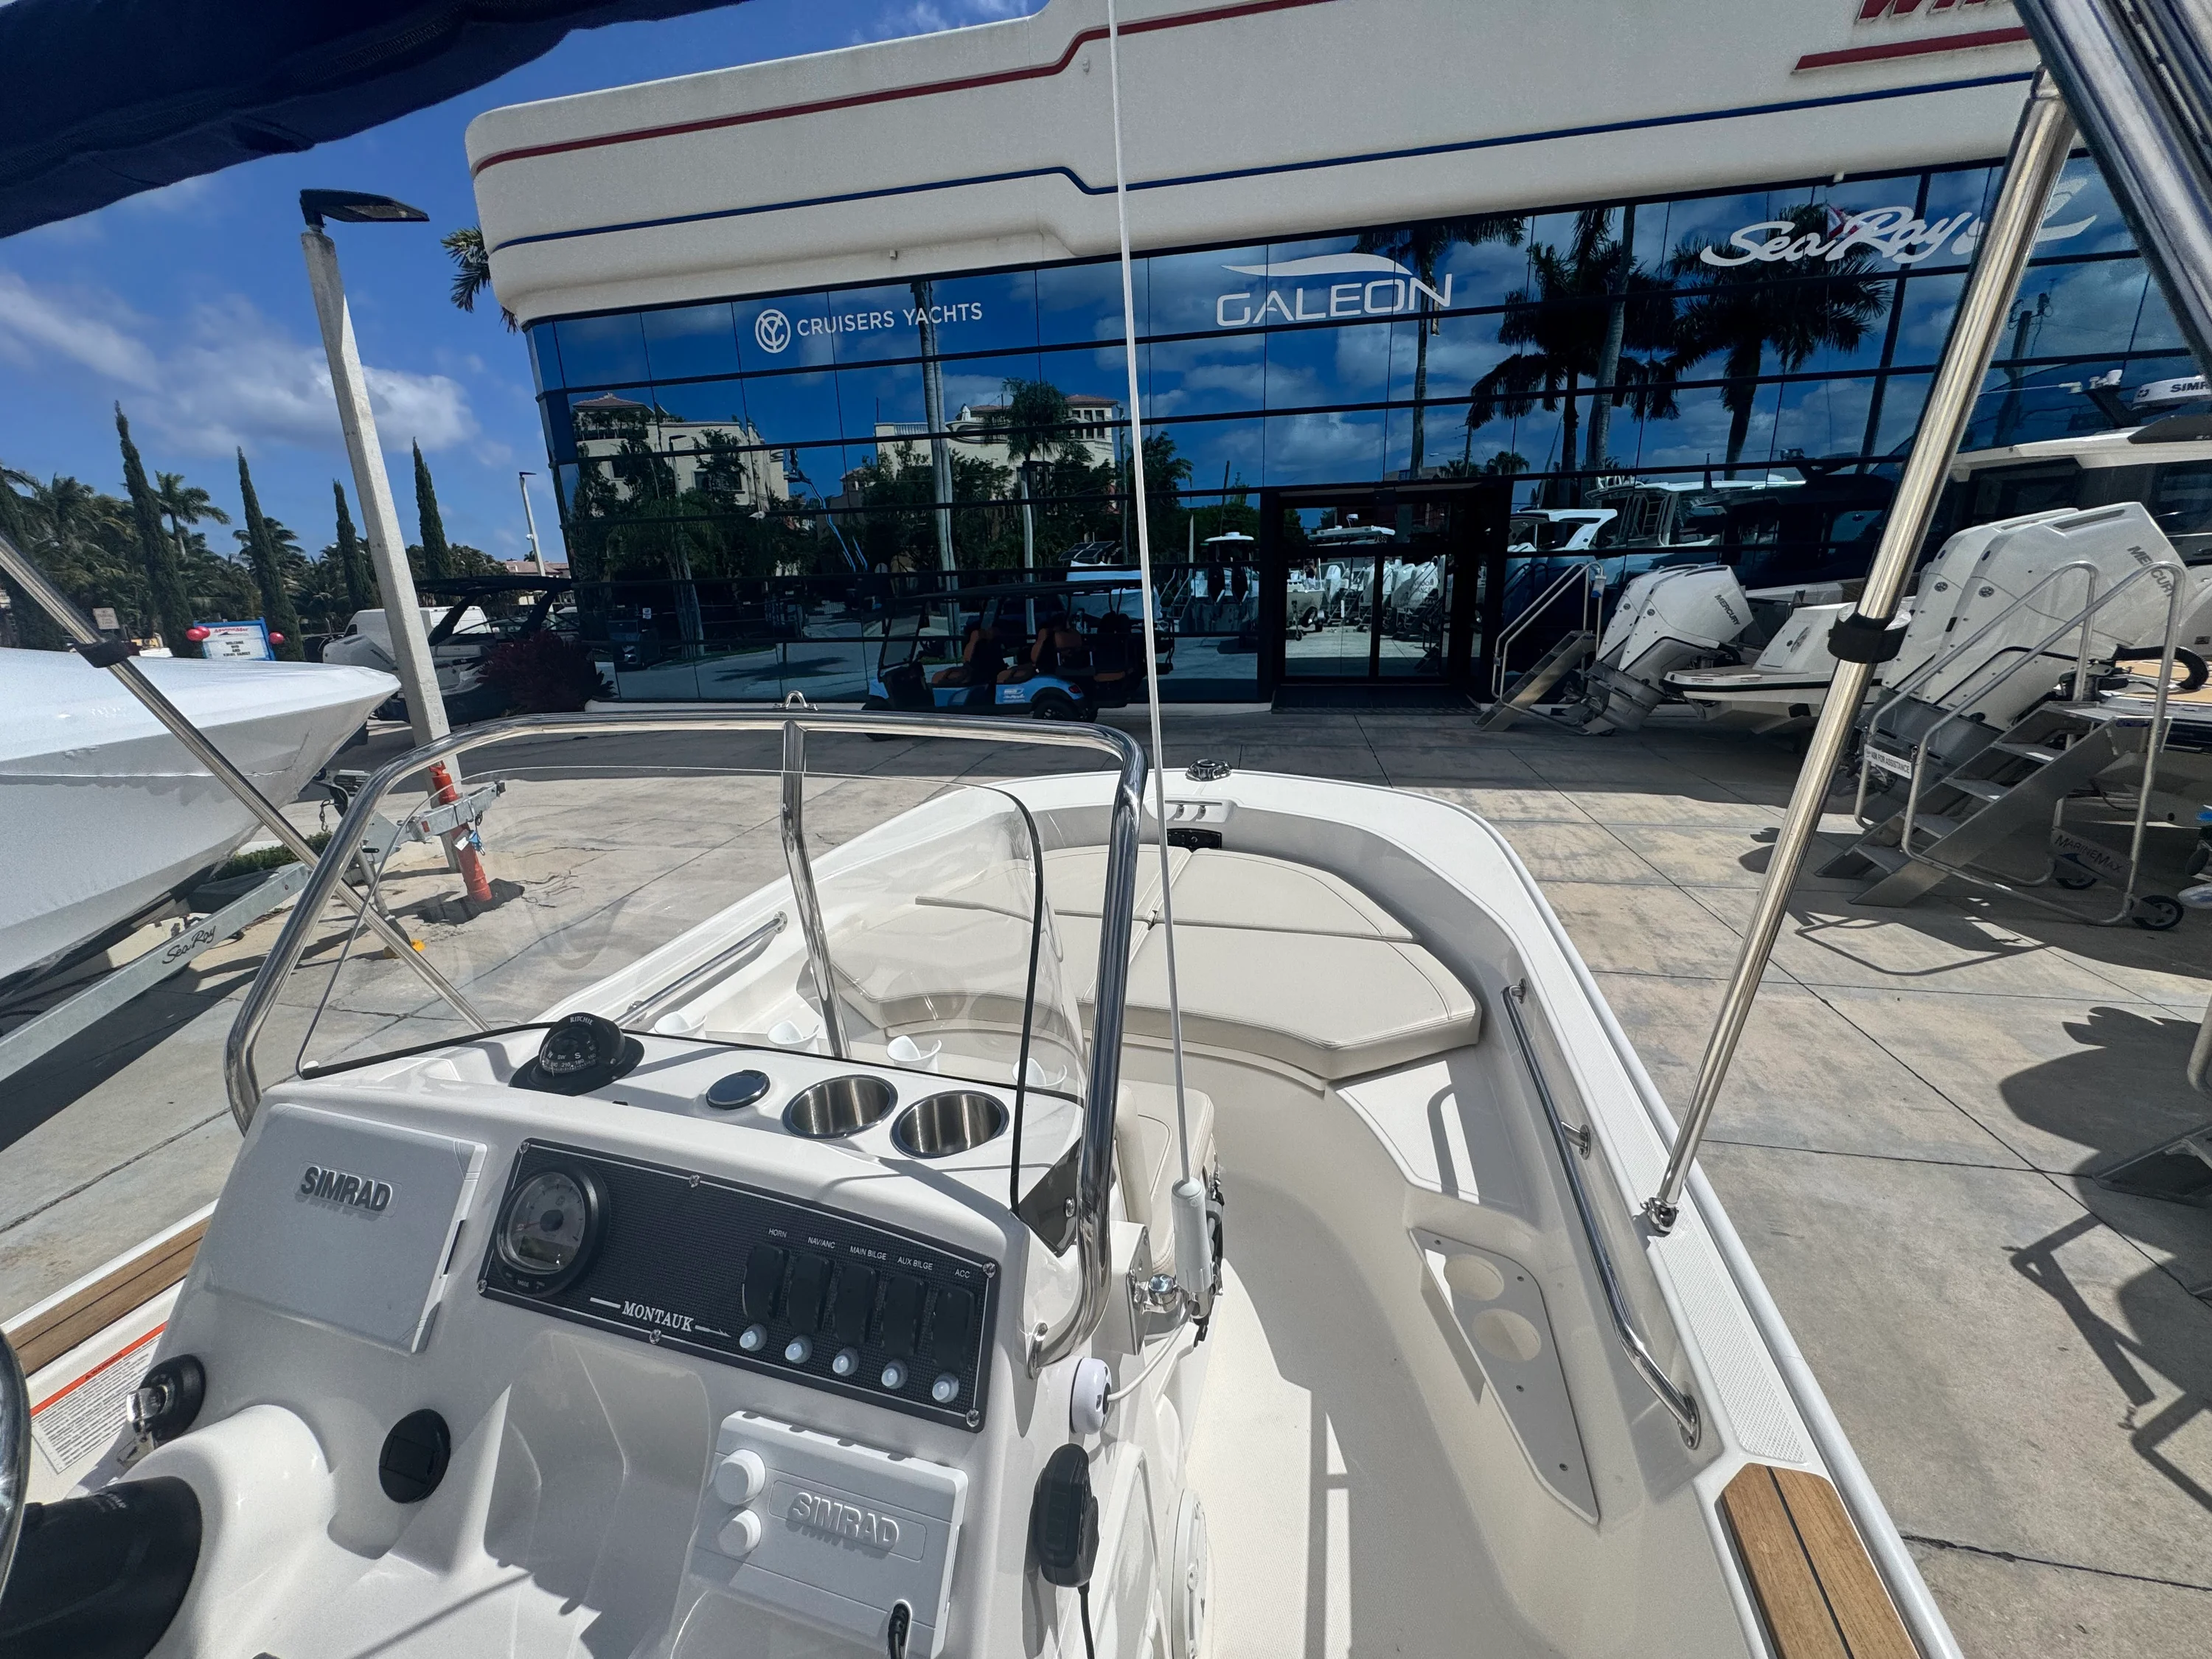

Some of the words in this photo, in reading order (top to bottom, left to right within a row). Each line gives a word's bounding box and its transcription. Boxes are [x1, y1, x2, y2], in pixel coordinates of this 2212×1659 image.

[1700, 220, 1836, 267] Sea
[1830, 206, 1972, 264] Ray
[1217, 274, 1453, 327] GALEON
[797, 310, 894, 336] CRUISERS
[902, 302, 983, 326] YACHTS
[2126, 545, 2174, 597] MECUR
[1714, 594, 1741, 625] MERCURY
[1885, 757, 1910, 774] ASSISTANCE
[162, 945, 192, 964] Sea
[191, 925, 217, 949] Ray
[570, 1015, 594, 1026] RITCHIE
[301, 1165, 393, 1211] SIMRAD
[768, 1228, 787, 1239] HORN
[807, 1236, 836, 1249] NAV/ANC
[849, 1245, 866, 1256] MAIN
[867, 1248, 887, 1261] BILGE
[897, 1256, 912, 1267] AUX
[913, 1259, 933, 1270] BILGE
[954, 1268, 971, 1279] ACC
[622, 1301, 695, 1332] MONTAUK
[787, 1492, 900, 1552] SIMRAD
